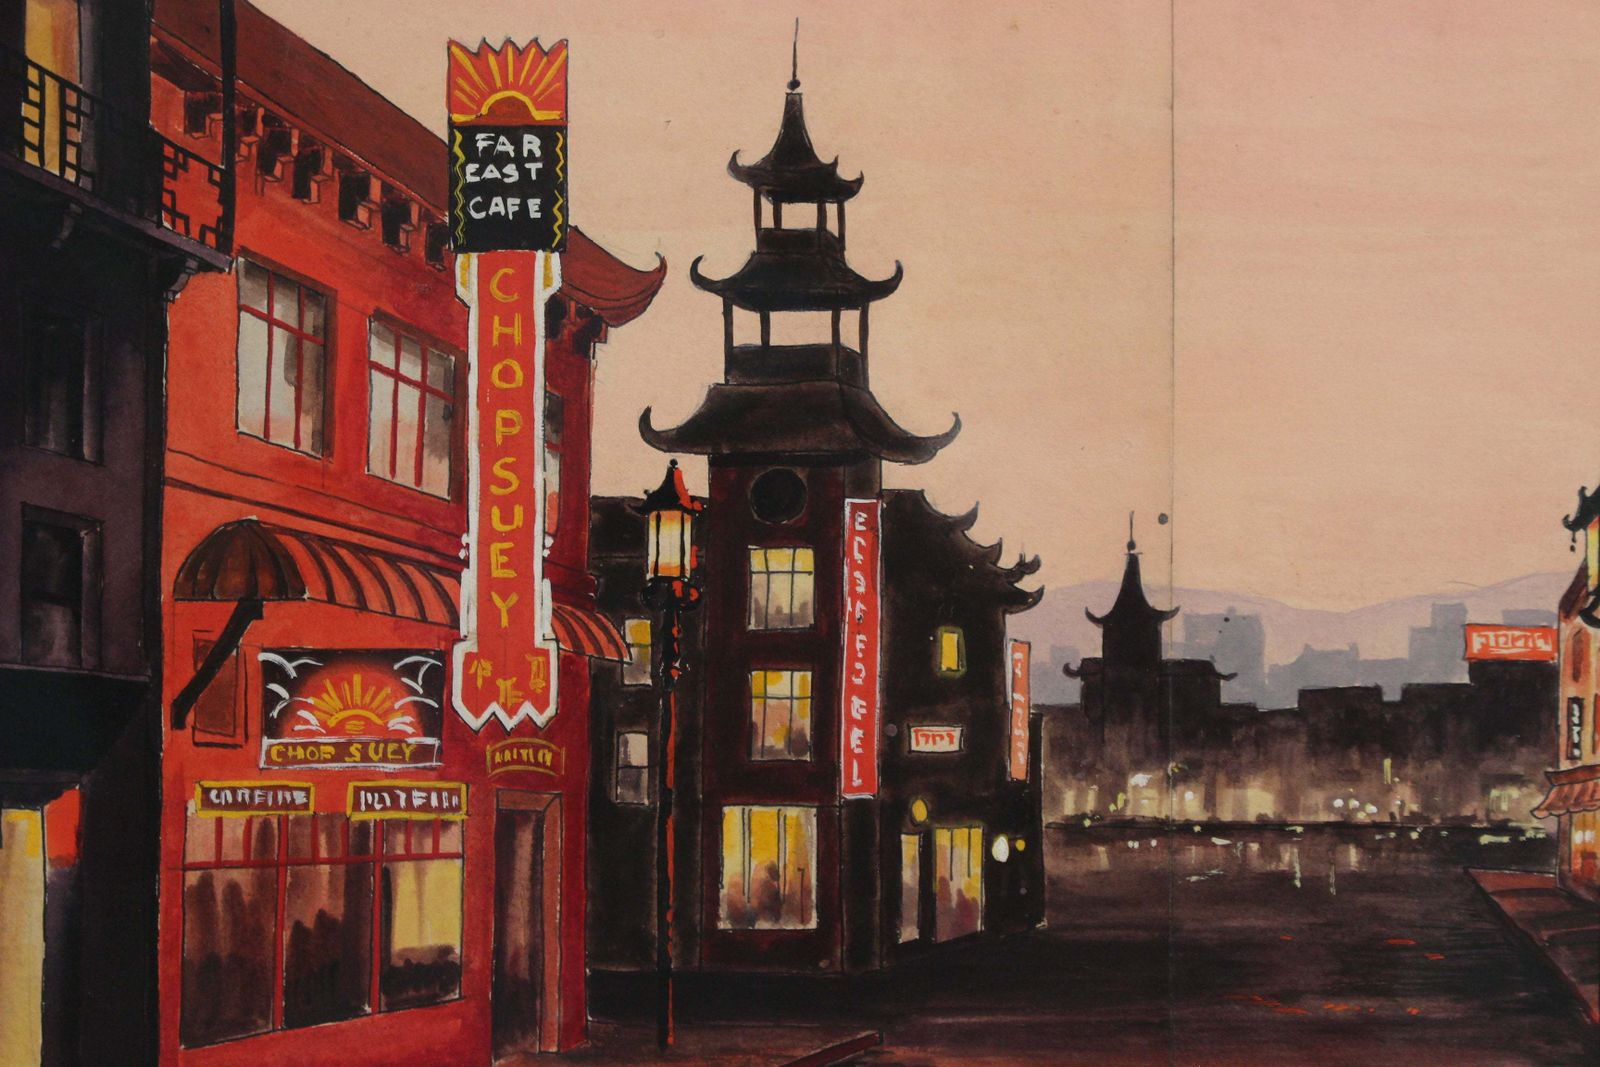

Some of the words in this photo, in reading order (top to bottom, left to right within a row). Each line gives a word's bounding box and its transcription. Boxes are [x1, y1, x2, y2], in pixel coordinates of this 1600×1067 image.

[475, 133, 542, 157] FAR
[465, 162, 543, 183] EAST
[467, 196, 542, 220] CAFE
[270, 744, 336, 762] CHOP
[344, 742, 417, 762] SUEY
